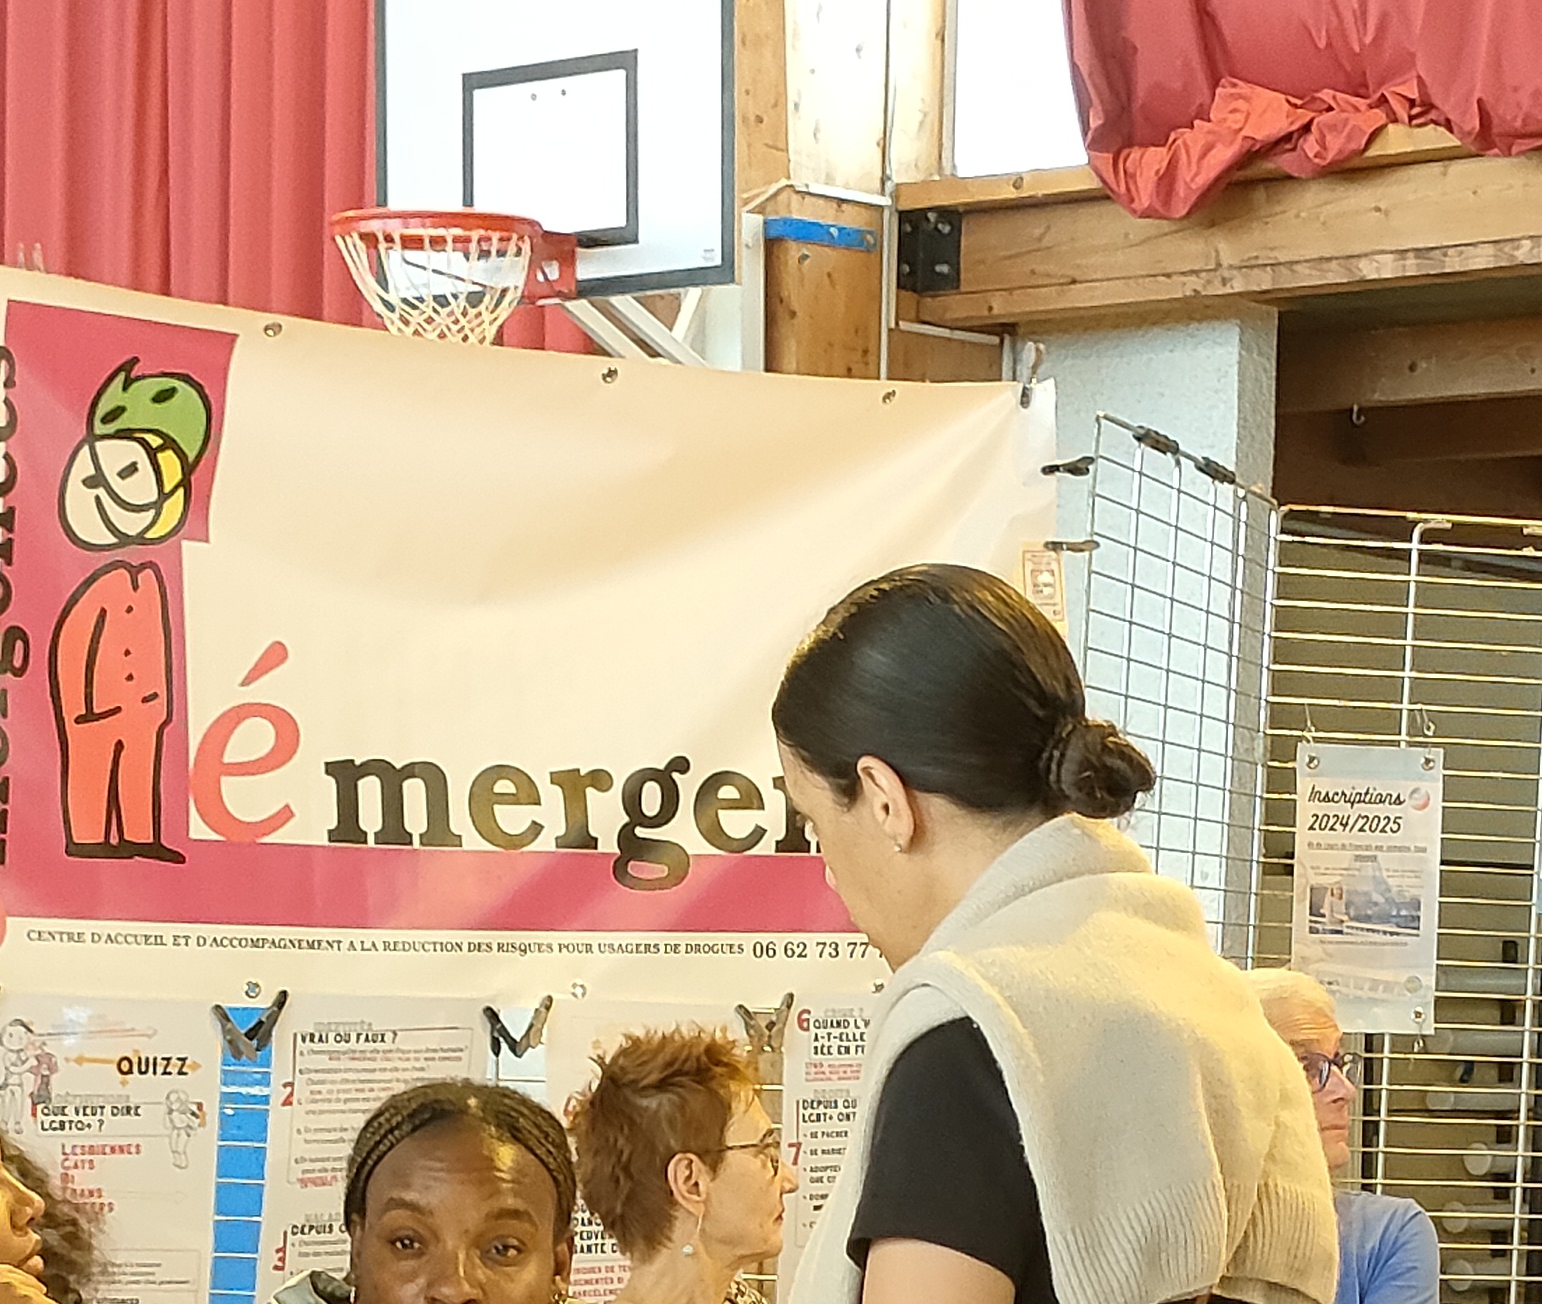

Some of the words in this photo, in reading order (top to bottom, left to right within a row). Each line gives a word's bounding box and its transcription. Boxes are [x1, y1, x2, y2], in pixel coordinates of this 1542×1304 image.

[1307, 784, 1406, 809] Inscriptions
[1307, 813, 1403, 834] 2024/2025
[27, 929, 86, 943] CENTRE
[172, 935, 191, 947] ET
[359, 939, 379, 952] LA
[383, 939, 463, 953] REDUCTION
[467, 941, 494, 954] DES
[497, 941, 554, 957] RISQUES
[558, 942, 594, 955] POUR
[598, 943, 660, 956] USAGERS
[664, 943, 682, 955] DE
[684, 943, 745, 956] DROGUES
[752, 941, 777, 959] 06
[783, 941, 808, 959] 62
[815, 941, 840, 959] 73
[846, 941, 870, 959] 77
[813, 1019, 850, 1030] QUAND
[300, 1032, 329, 1044] VRAI
[334, 1032, 351, 1044] OU
[356, 1032, 387, 1044] FAUX
[391, 1030, 398, 1044] ?
[837, 1045, 851, 1055] EN
[116, 1056, 190, 1076] QUIZZ
[41, 1105, 68, 1117] QUE
[74, 1105, 106, 1117] VEUT
[110, 1105, 142, 1117] DIRE
[802, 1099, 839, 1110] DEPUIS
[802, 1112, 834, 1123] LGBT+
[41, 1119, 93, 1132] LGBTQ+
[97, 1119, 105, 1132] ?
[787, 1142, 803, 1166] 7
[291, 1223, 334, 1236] DEPUIS
